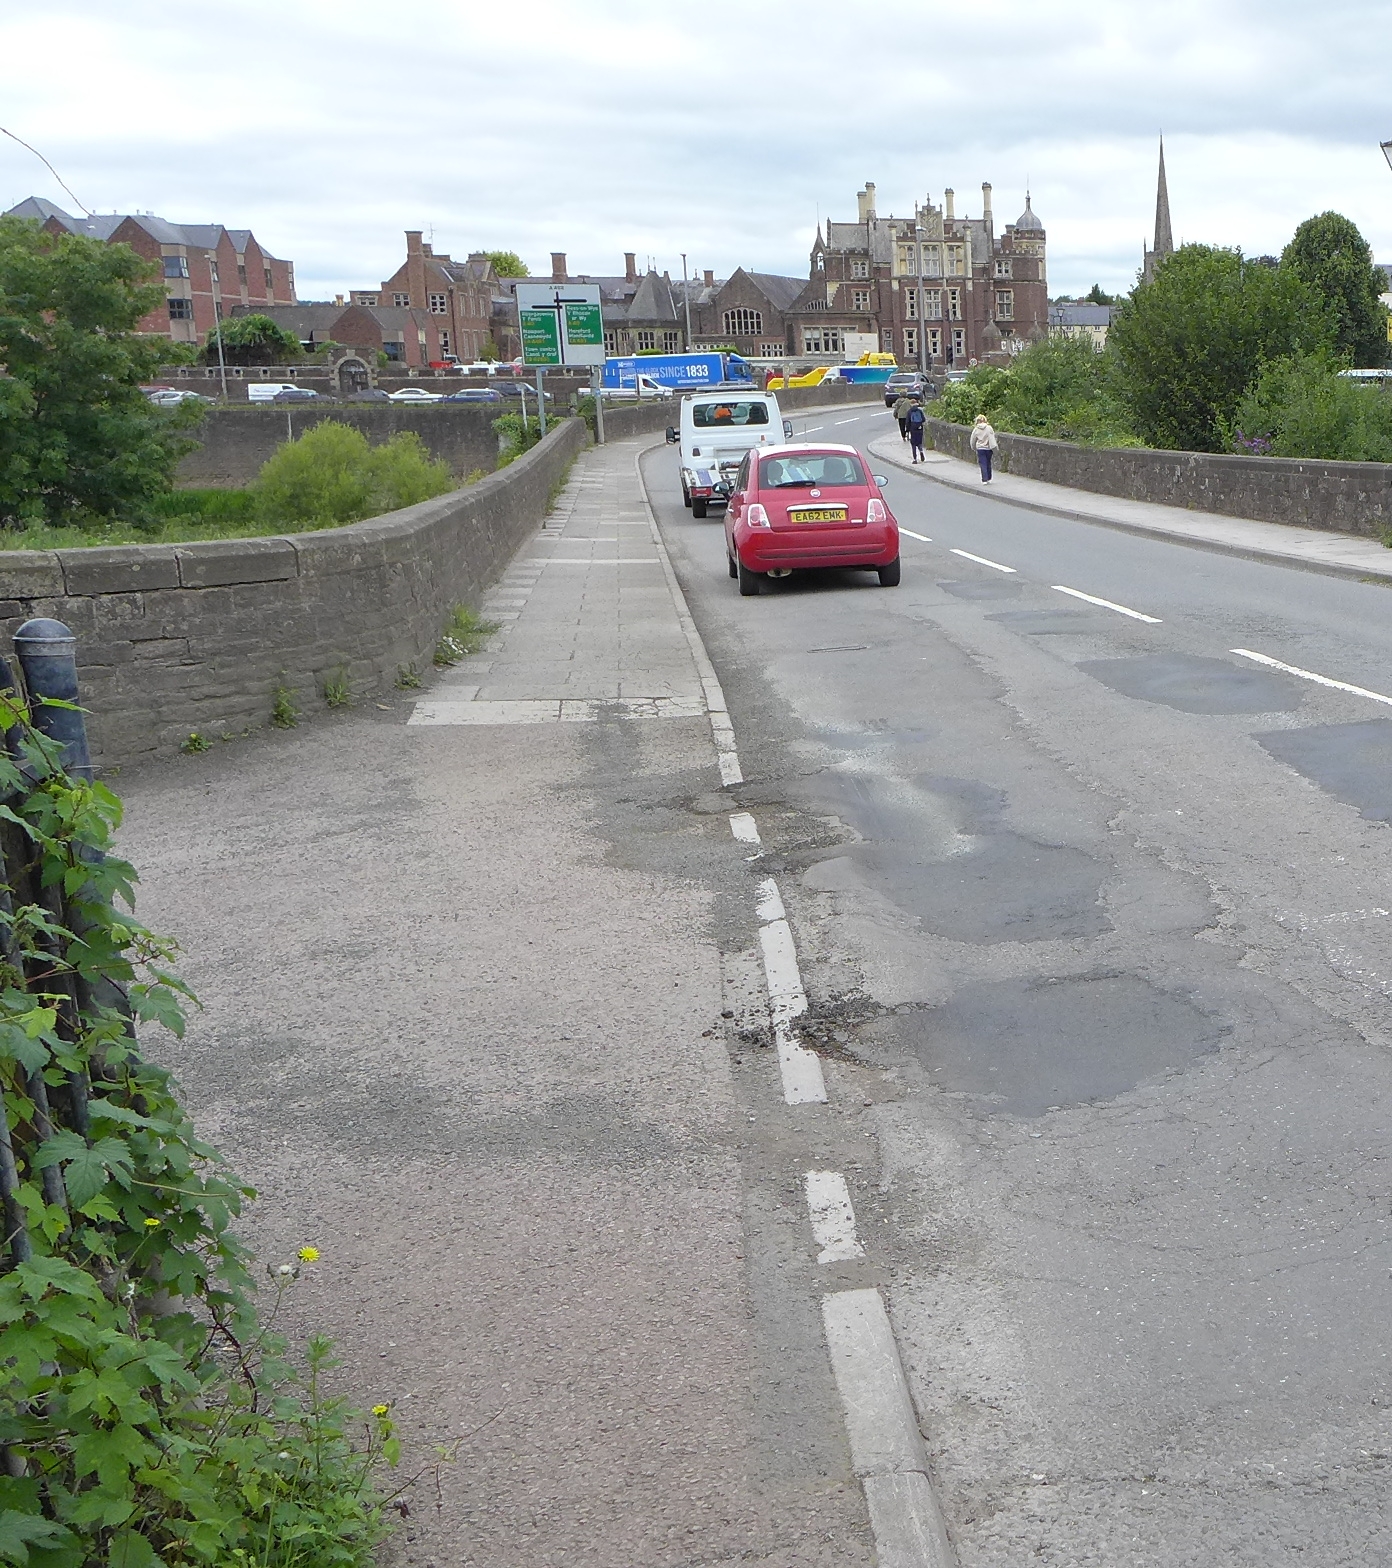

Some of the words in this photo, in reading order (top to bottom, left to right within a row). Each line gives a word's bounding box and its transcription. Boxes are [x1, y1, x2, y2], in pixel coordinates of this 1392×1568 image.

[660, 366, 686, 378] SINCE
[686, 364, 709, 378] 1833
[795, 512, 820, 521] EA62
